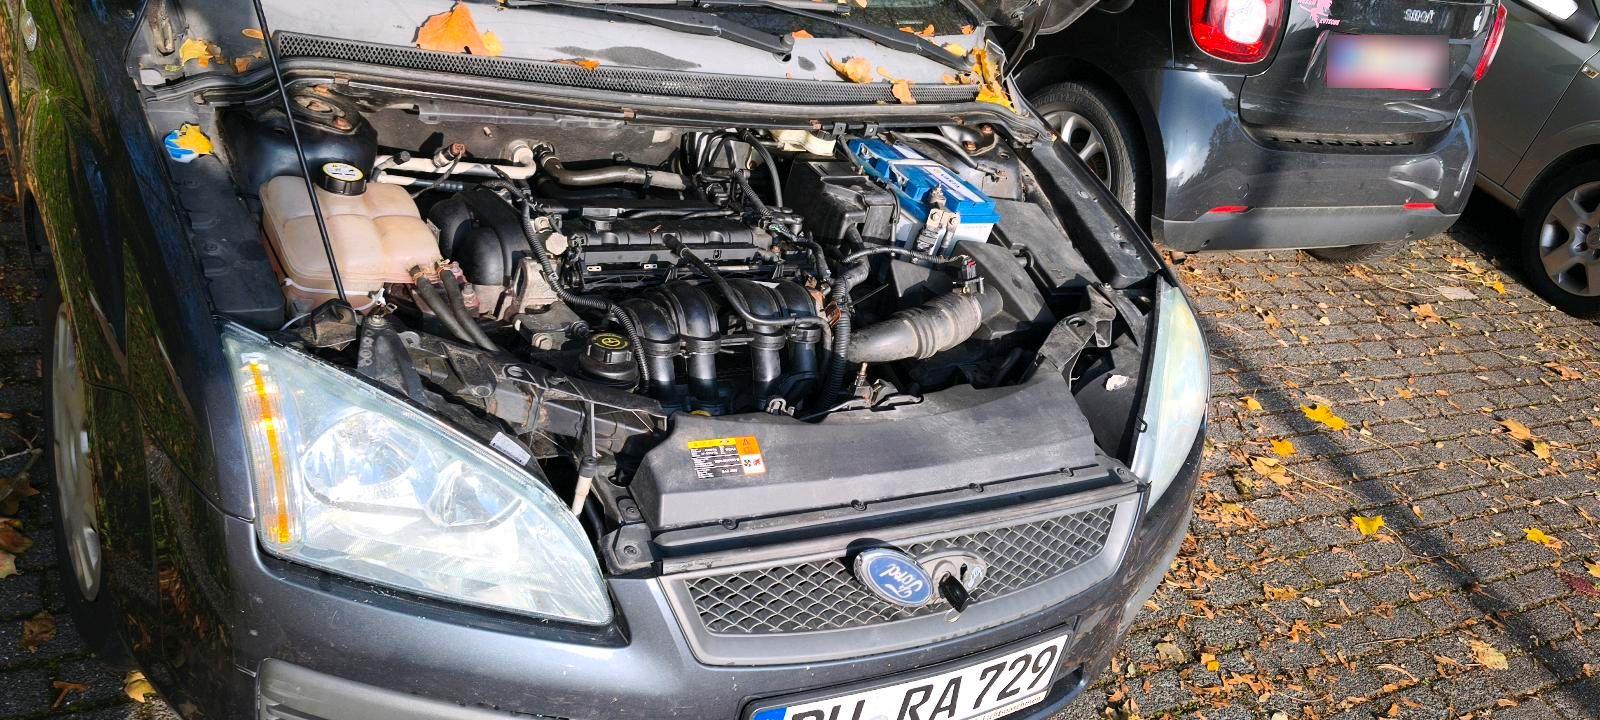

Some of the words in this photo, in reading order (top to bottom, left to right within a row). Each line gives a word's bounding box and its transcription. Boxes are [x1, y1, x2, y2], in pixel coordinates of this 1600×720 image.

[879, 563, 924, 599] Ford
[896, 676, 962, 720] RA
[973, 645, 1058, 710] 729
